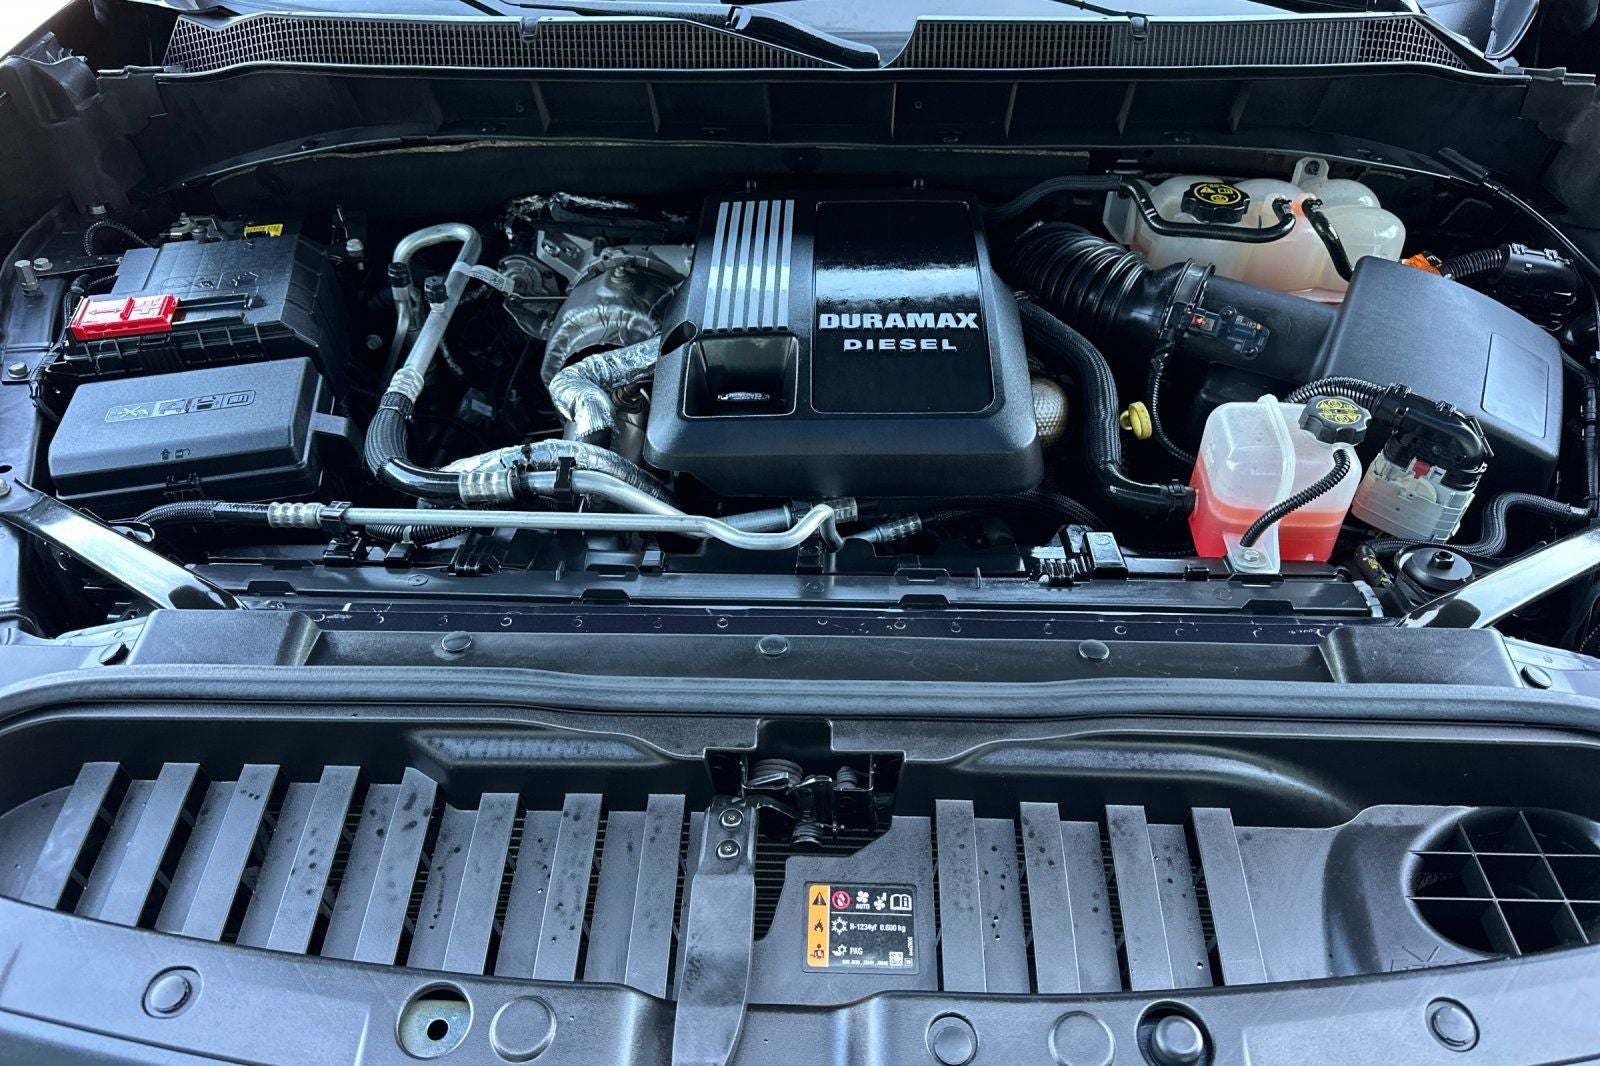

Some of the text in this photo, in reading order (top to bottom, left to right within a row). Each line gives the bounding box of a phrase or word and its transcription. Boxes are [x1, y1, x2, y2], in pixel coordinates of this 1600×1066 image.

[819, 313, 979, 329] DURAMAX
[843, 339, 957, 351] DIESEL
[850, 923, 877, 932] R-1234yf
[898, 925, 906, 933] kg
[850, 947, 863, 955] PAG
